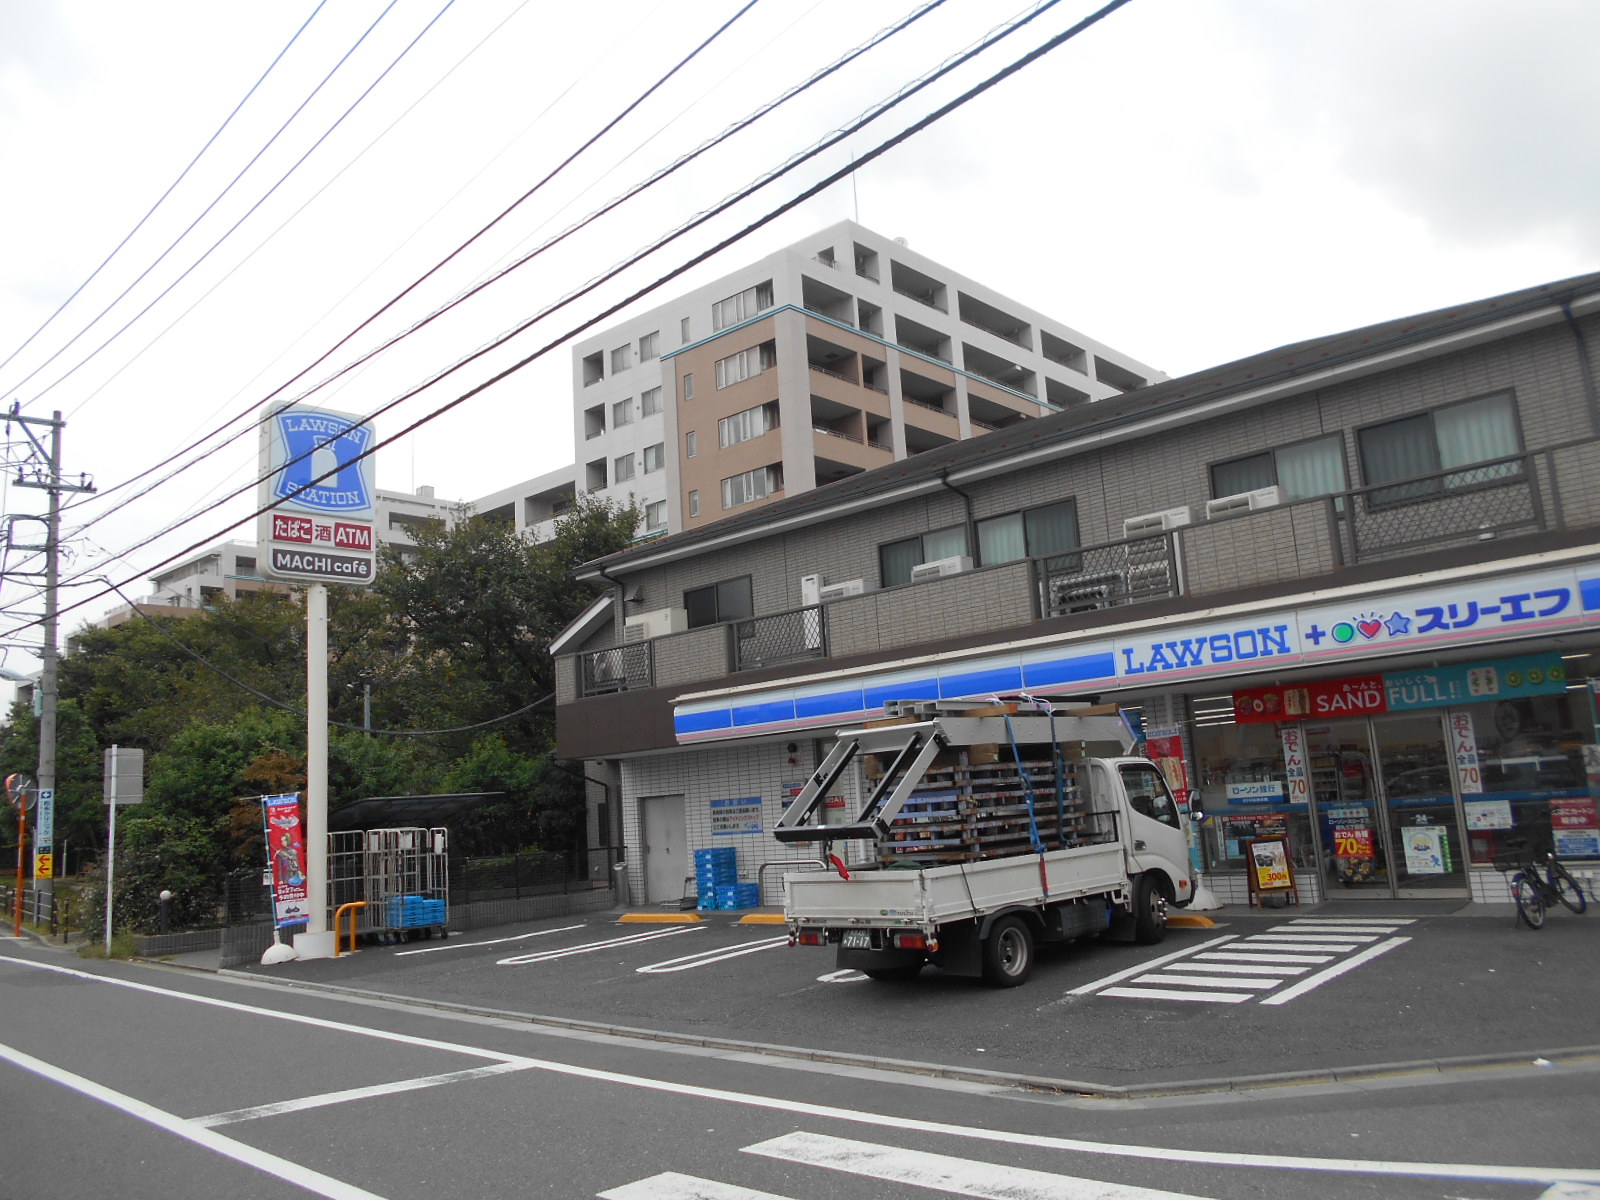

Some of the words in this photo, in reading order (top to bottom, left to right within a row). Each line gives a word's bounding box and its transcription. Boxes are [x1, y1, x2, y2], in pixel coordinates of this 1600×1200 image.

[286, 419, 362, 444] LAWSON
[286, 481, 361, 505] STATION
[275, 518, 312, 540] たばこ
[315, 525, 332, 542] 酒
[335, 527, 370, 546] ATM
[277, 553, 331, 572] MACHI
[334, 561, 368, 574] café
[1122, 624, 1291, 676] LAWSON
[1415, 587, 1571, 633] スリーエフ
[1317, 689, 1381, 713] SAND
[1453, 714, 1474, 753] おでん
[1284, 730, 1301, 766] おでん
[1290, 780, 1306, 795] 70
[1459, 767, 1479, 784] 70
[1232, 784, 1276, 795] ローソン銀行
[1335, 838, 1358, 855] 70
[847, 936, 870, 947] 71-17
